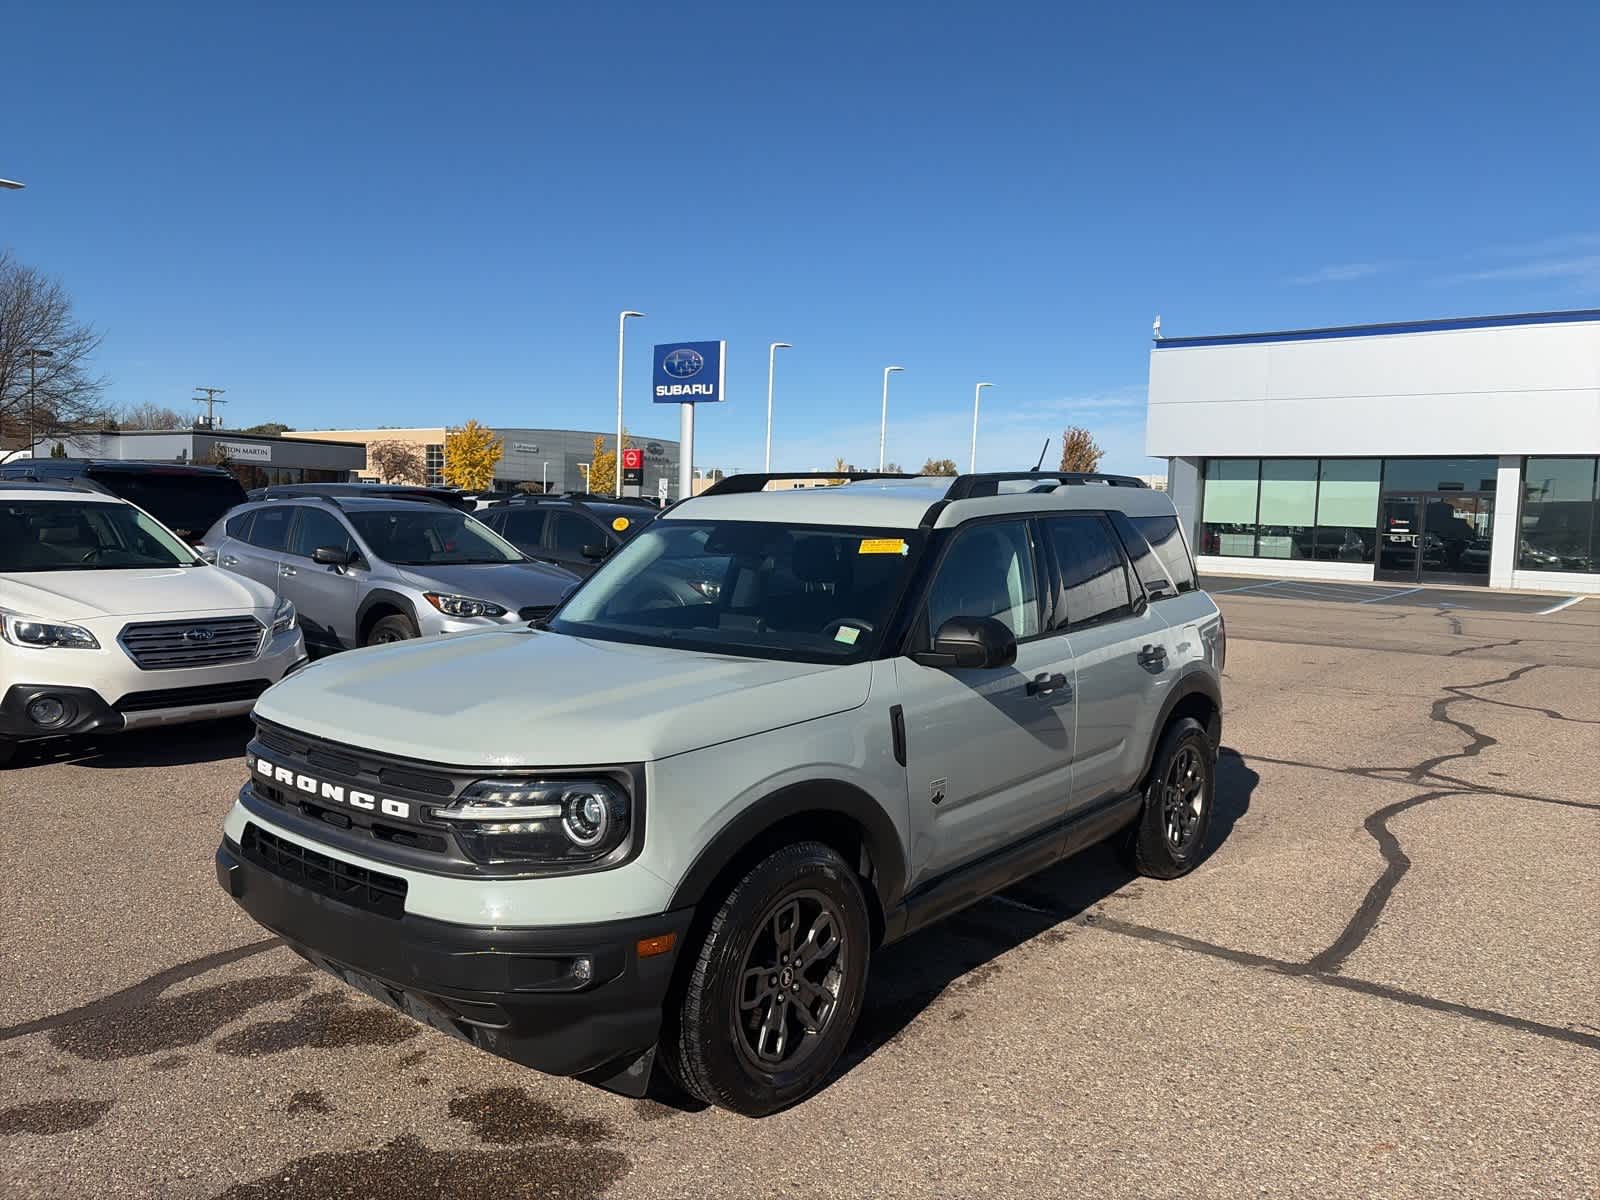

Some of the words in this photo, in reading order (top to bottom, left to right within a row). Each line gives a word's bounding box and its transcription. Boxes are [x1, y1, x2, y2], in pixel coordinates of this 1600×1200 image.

[656, 384, 713, 396] SUBARU
[242, 448, 268, 456] MARTIN
[257, 759, 410, 818] BRONCO
